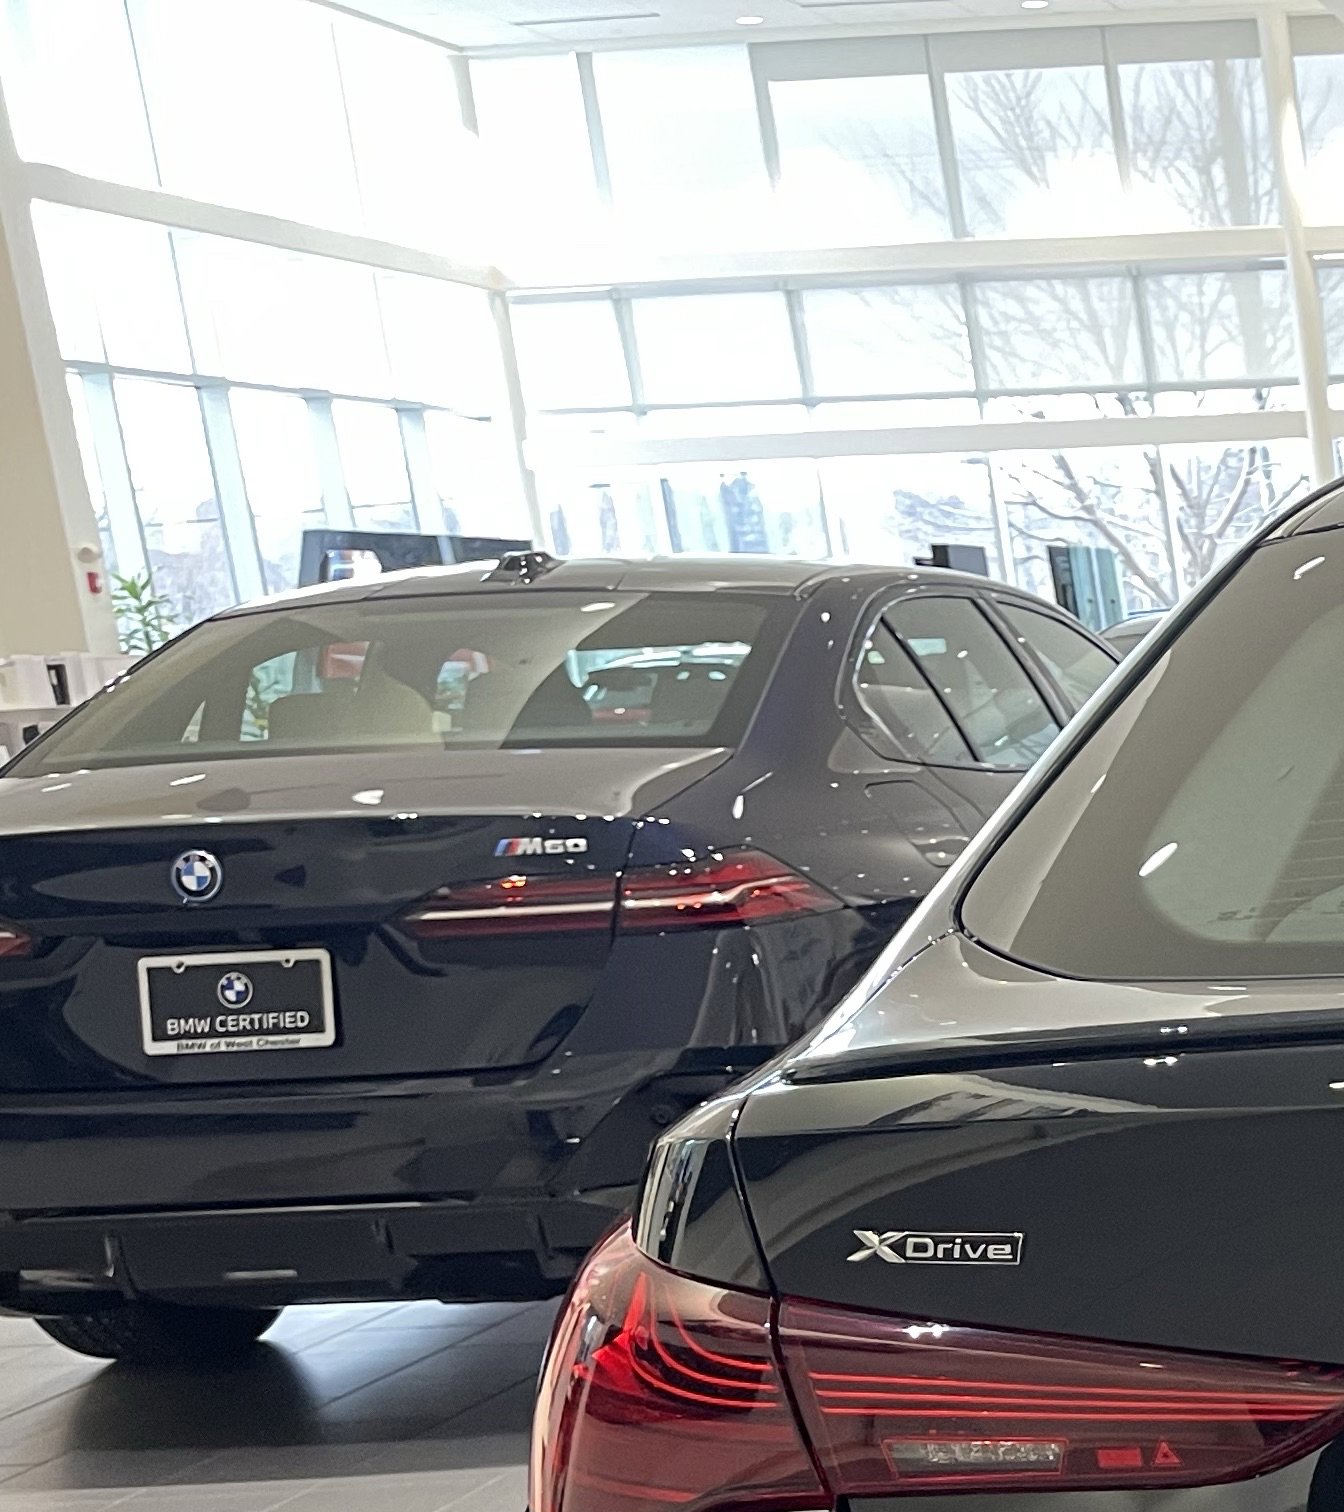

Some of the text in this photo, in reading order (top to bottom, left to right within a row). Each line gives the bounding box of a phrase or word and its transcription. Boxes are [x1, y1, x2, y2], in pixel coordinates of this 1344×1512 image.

[514, 837, 588, 856] M60
[166, 1011, 310, 1035] BMW CERTIFIED
